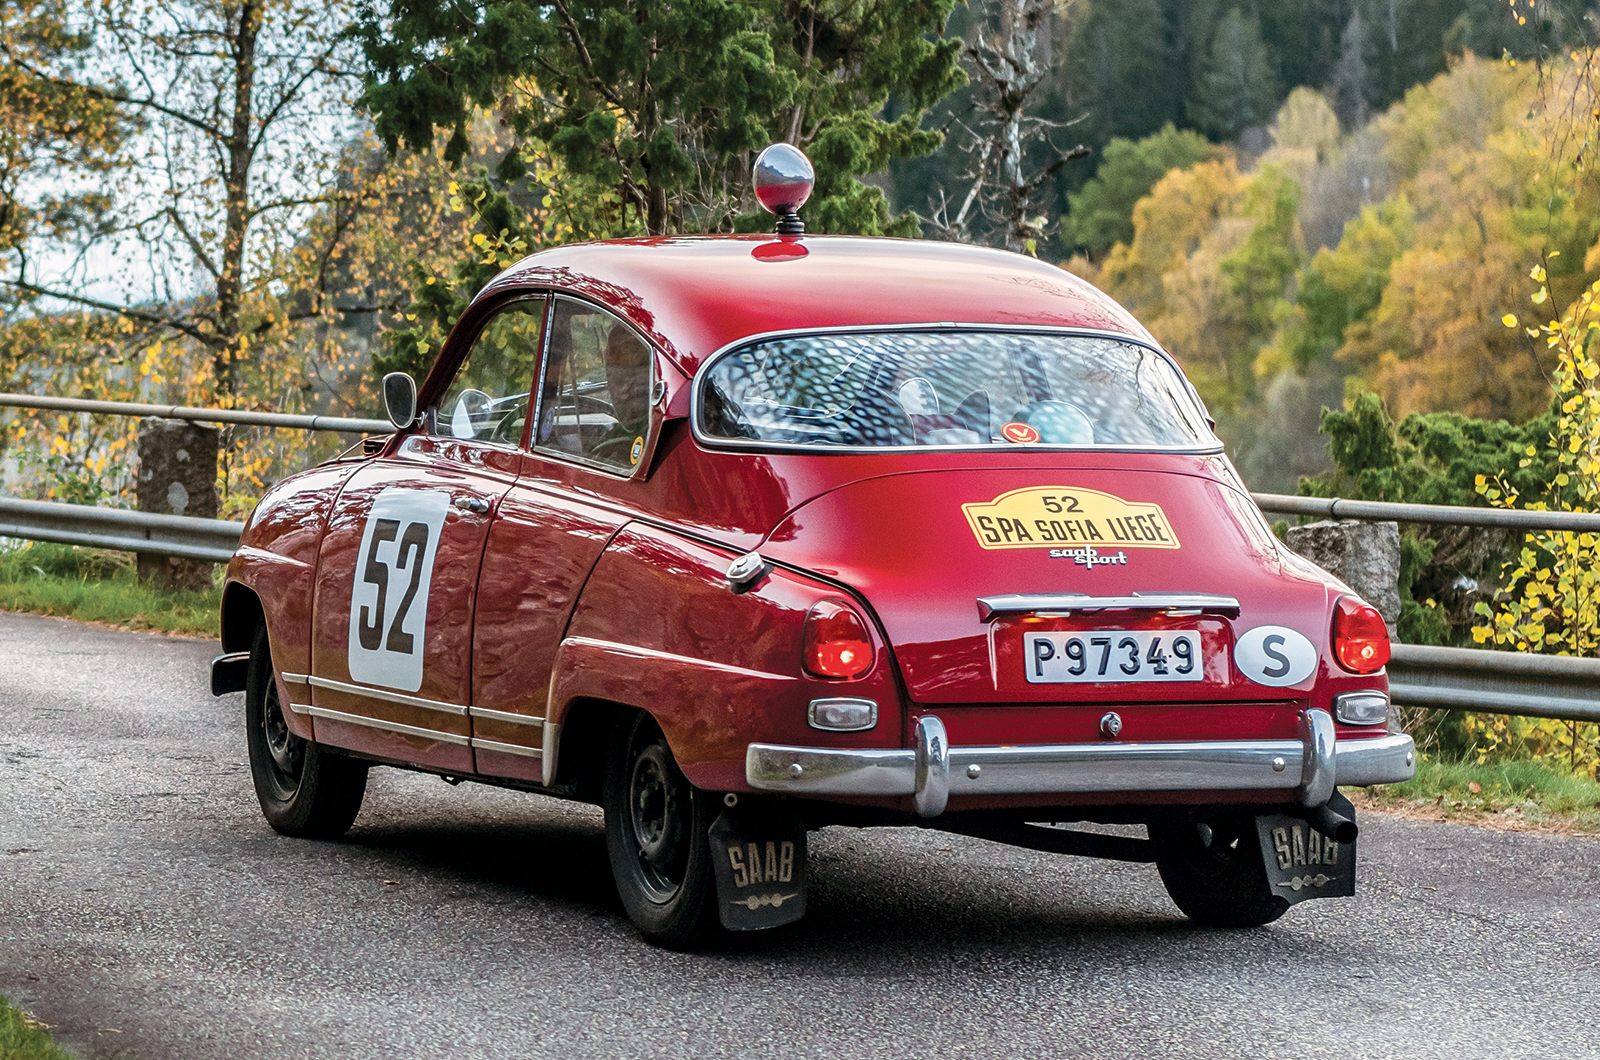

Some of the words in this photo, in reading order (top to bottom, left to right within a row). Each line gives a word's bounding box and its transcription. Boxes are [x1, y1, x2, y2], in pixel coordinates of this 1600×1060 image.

[1042, 496, 1084, 513] 52
[977, 516, 1034, 543] SPA
[1034, 519, 1104, 542] SOFIA
[1106, 513, 1170, 542] LIEGE
[1049, 544, 1098, 558] saab
[1074, 551, 1128, 570] sport
[359, 518, 429, 655] 52
[1262, 634, 1291, 678] S
[728, 841, 794, 888] SAAB
